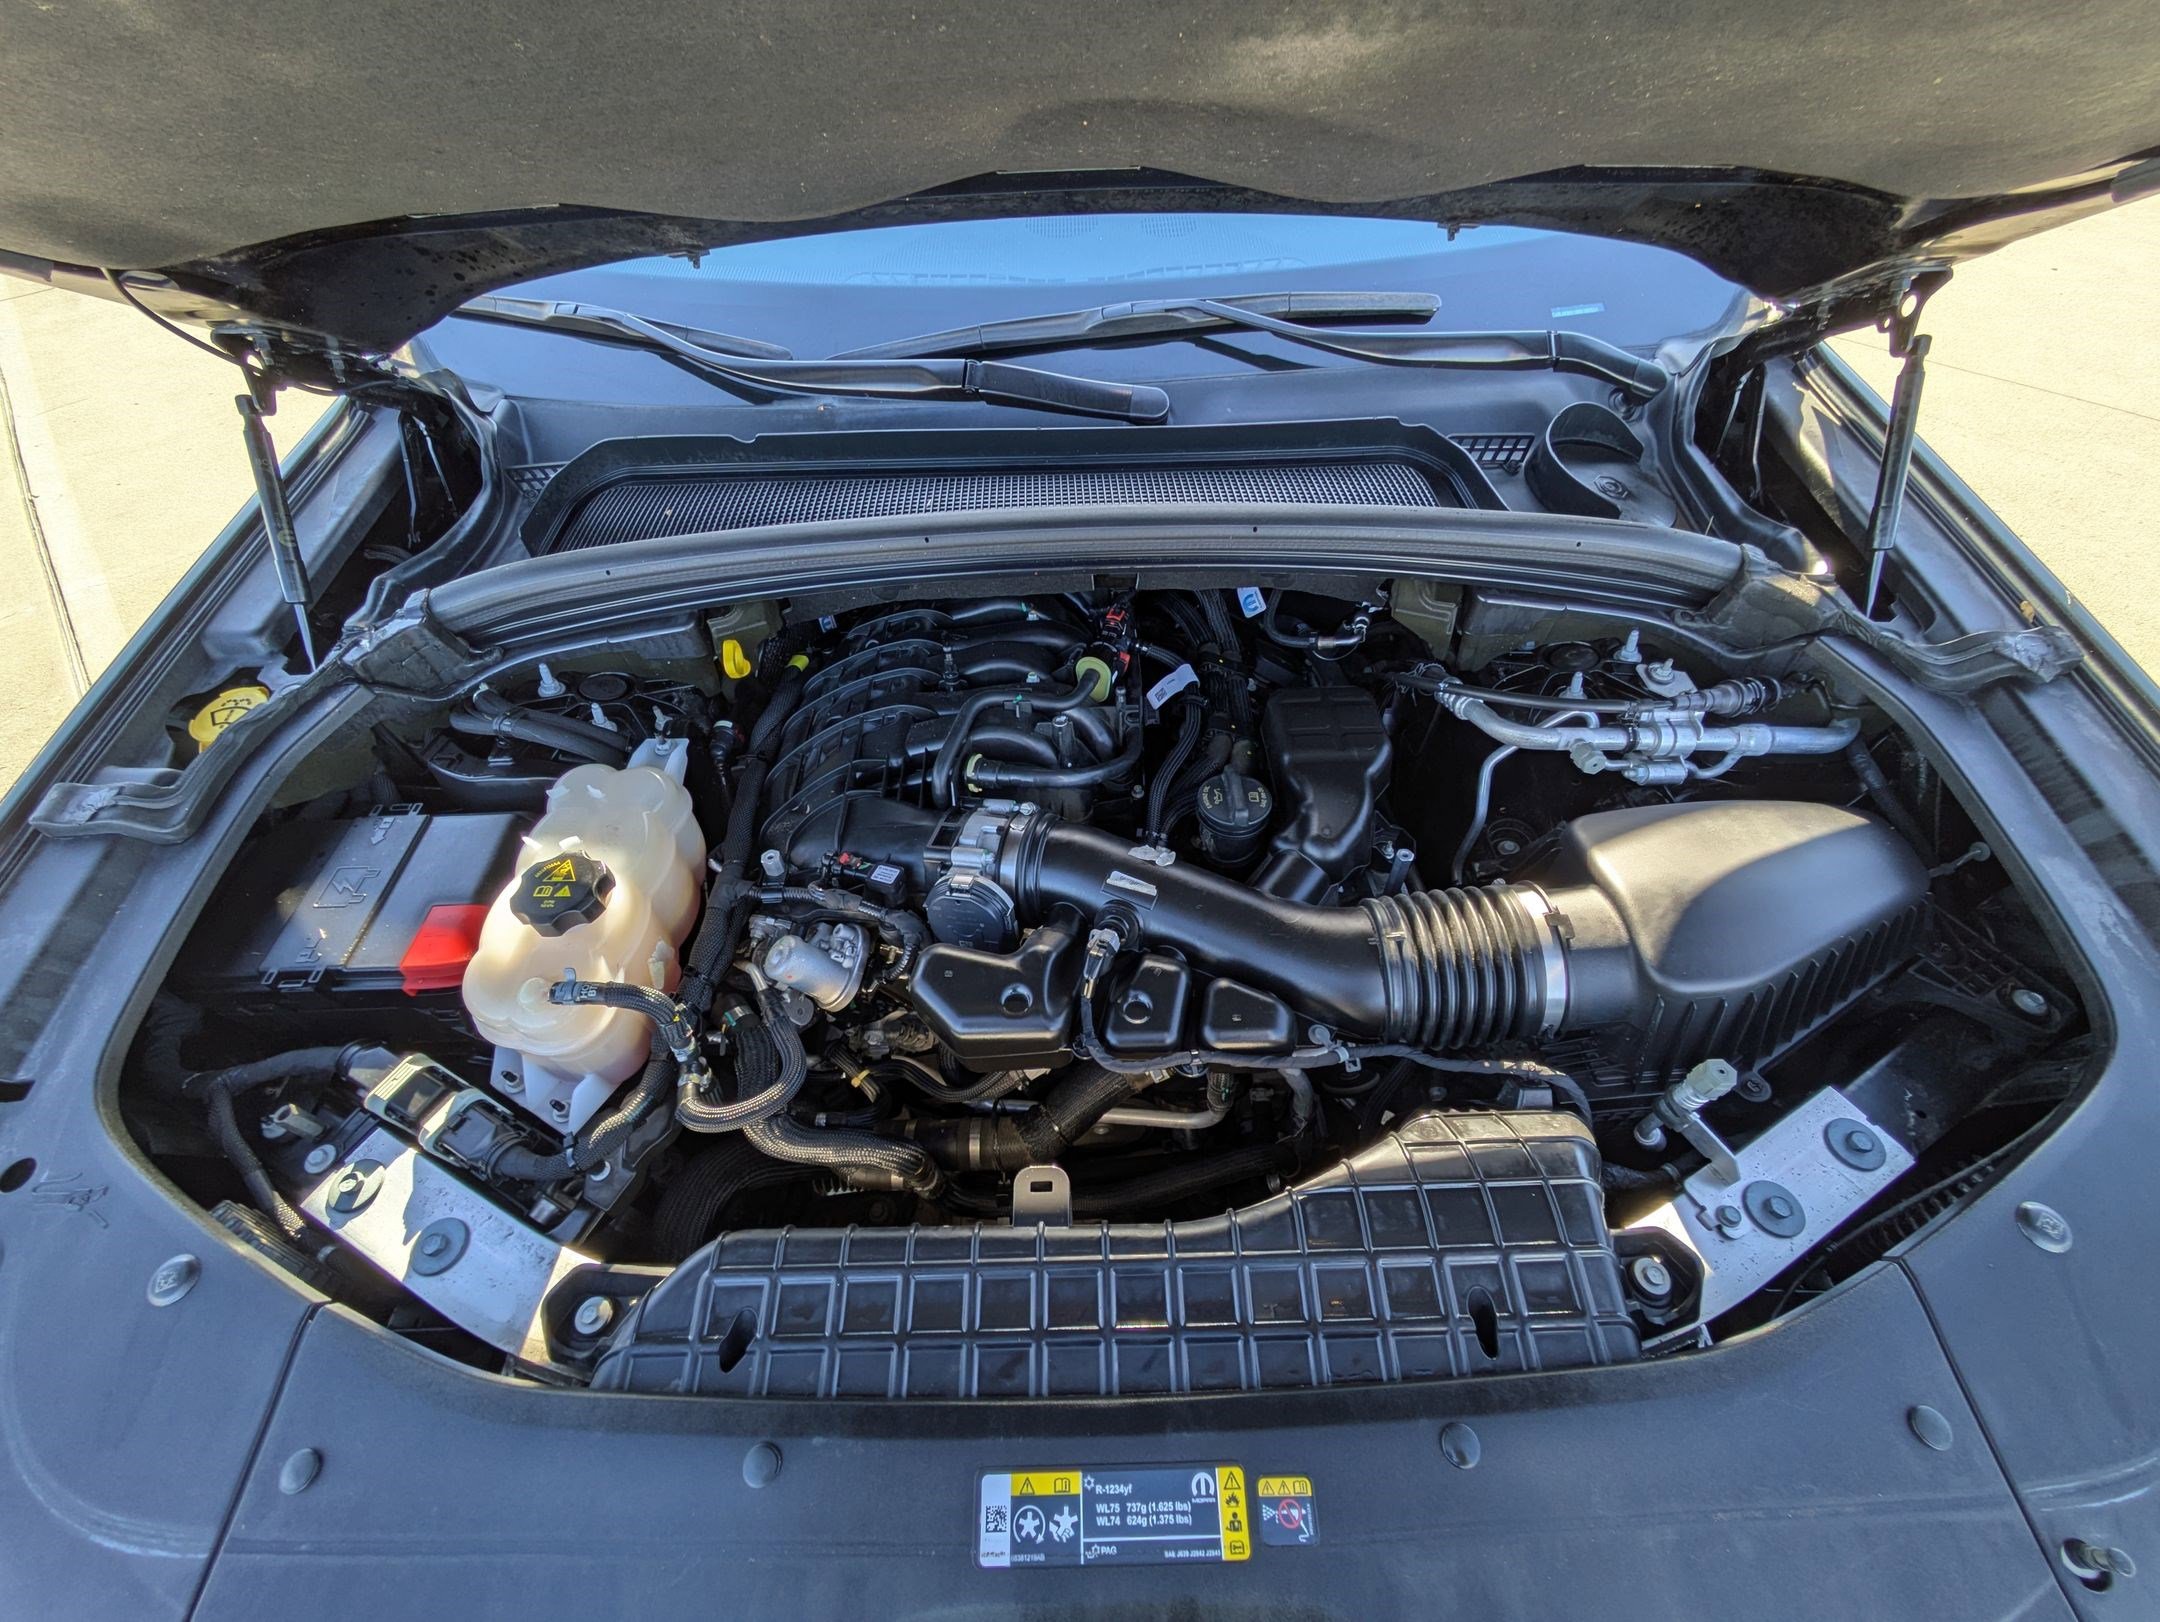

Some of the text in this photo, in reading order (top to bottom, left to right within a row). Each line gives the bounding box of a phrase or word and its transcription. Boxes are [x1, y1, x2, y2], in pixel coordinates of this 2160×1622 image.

[1095, 1483, 1132, 1495] R-1234yf
[1096, 1500, 1191, 1515] WL75 737g (1.625 lbs)
[1096, 1513, 1192, 1528] WL74 624g (1.375 lbs)
[1101, 1545, 1117, 1555] PAG
